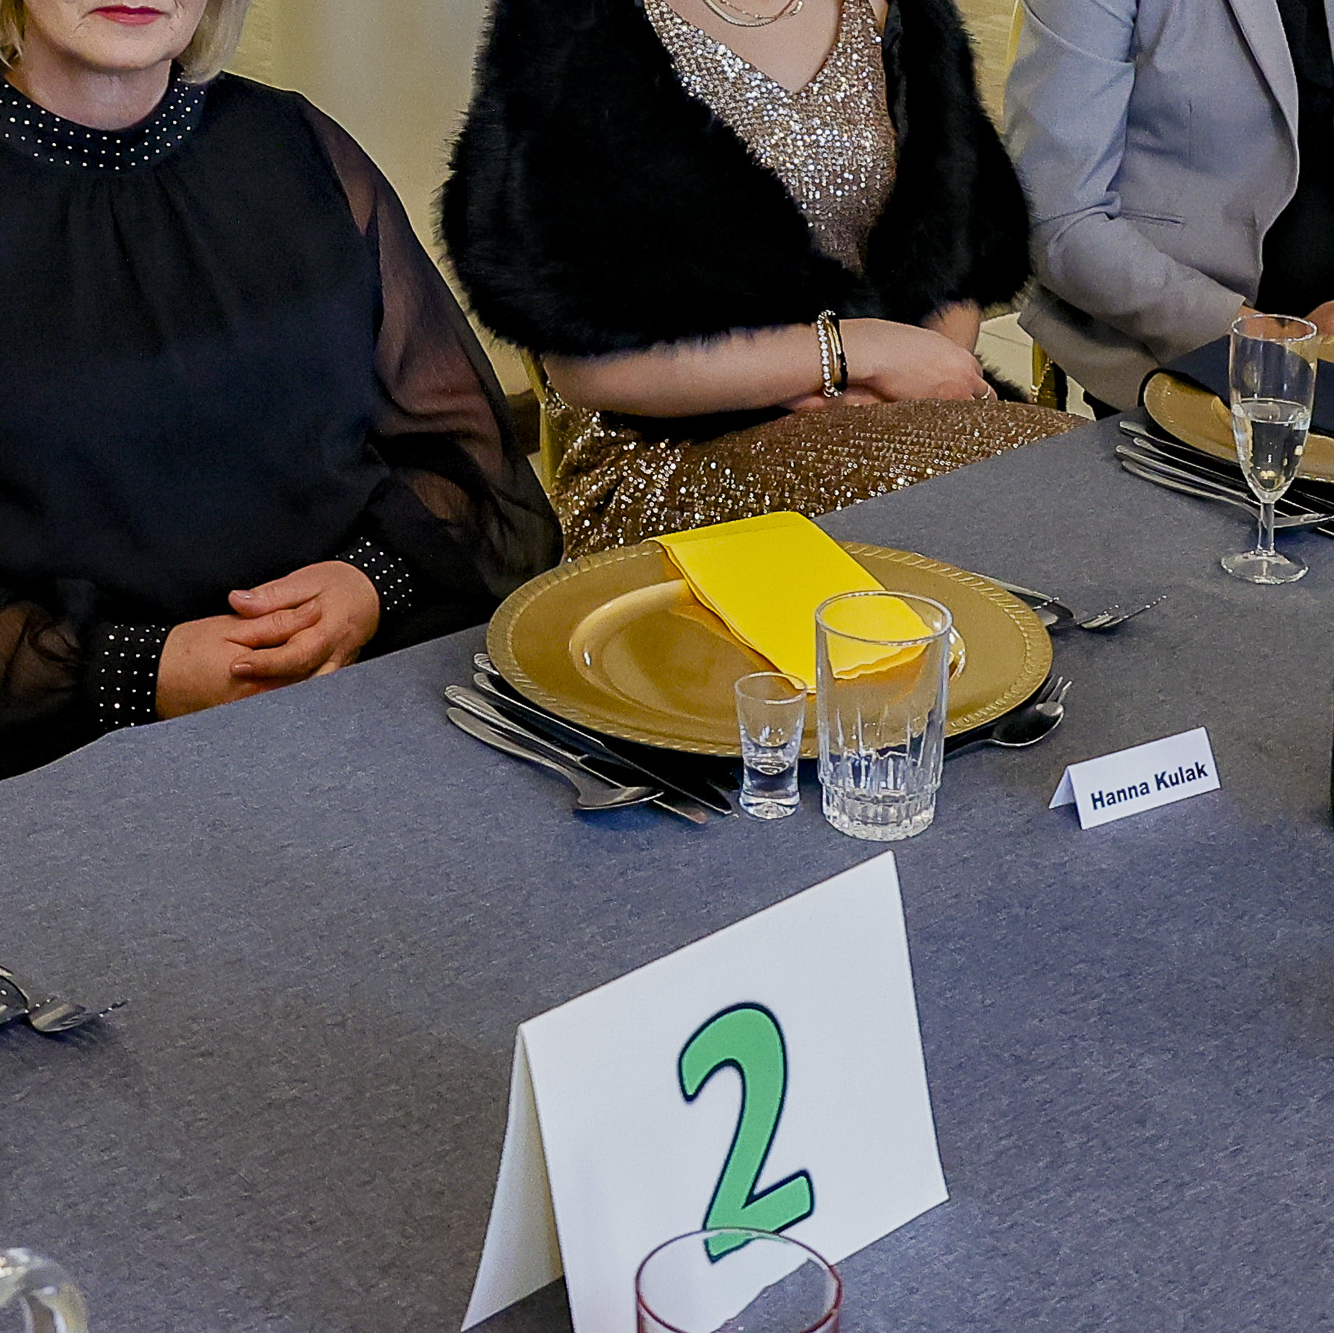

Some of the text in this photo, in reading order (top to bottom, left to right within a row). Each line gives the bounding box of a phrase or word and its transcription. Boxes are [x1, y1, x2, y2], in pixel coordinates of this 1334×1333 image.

[1090, 762, 1209, 810] Hanna Kulak
[679, 1001, 815, 1264] 2
